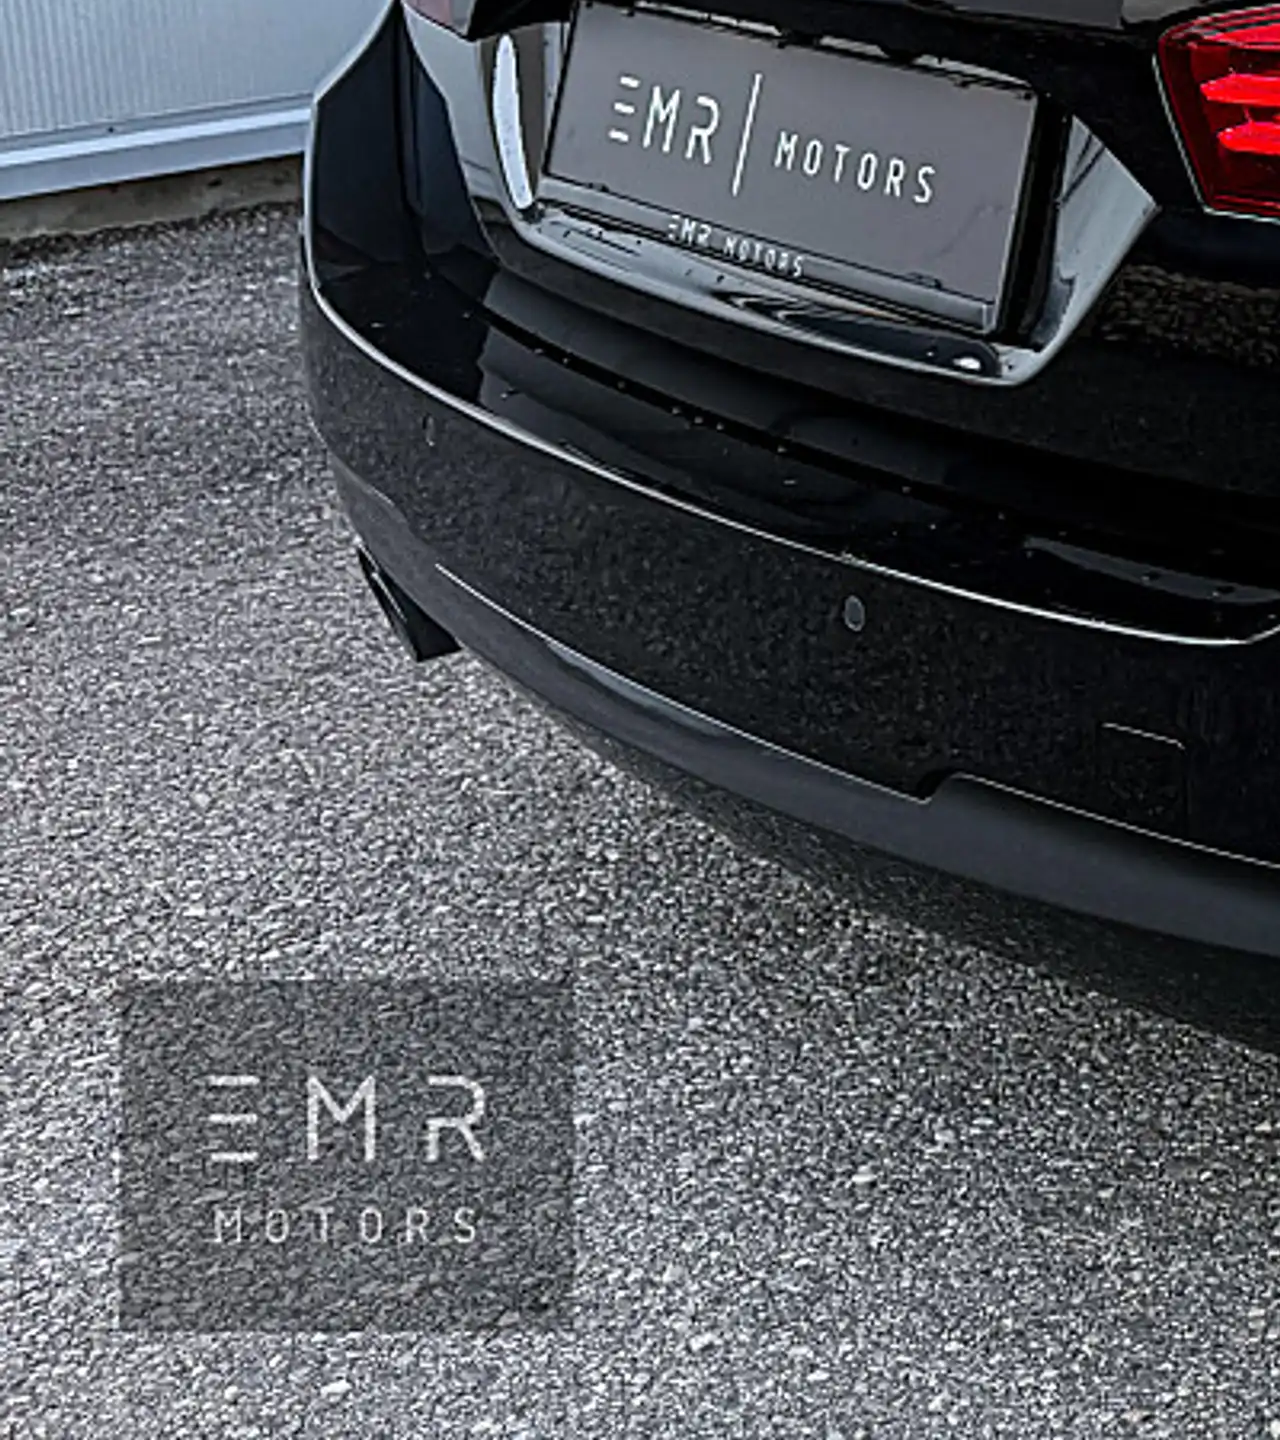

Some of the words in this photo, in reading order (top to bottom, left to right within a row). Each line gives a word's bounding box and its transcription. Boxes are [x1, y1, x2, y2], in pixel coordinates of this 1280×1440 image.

[608, 74, 720, 164] EMR
[774, 133, 936, 204] MOTORS
[723, 235, 805, 278] MOTORS
